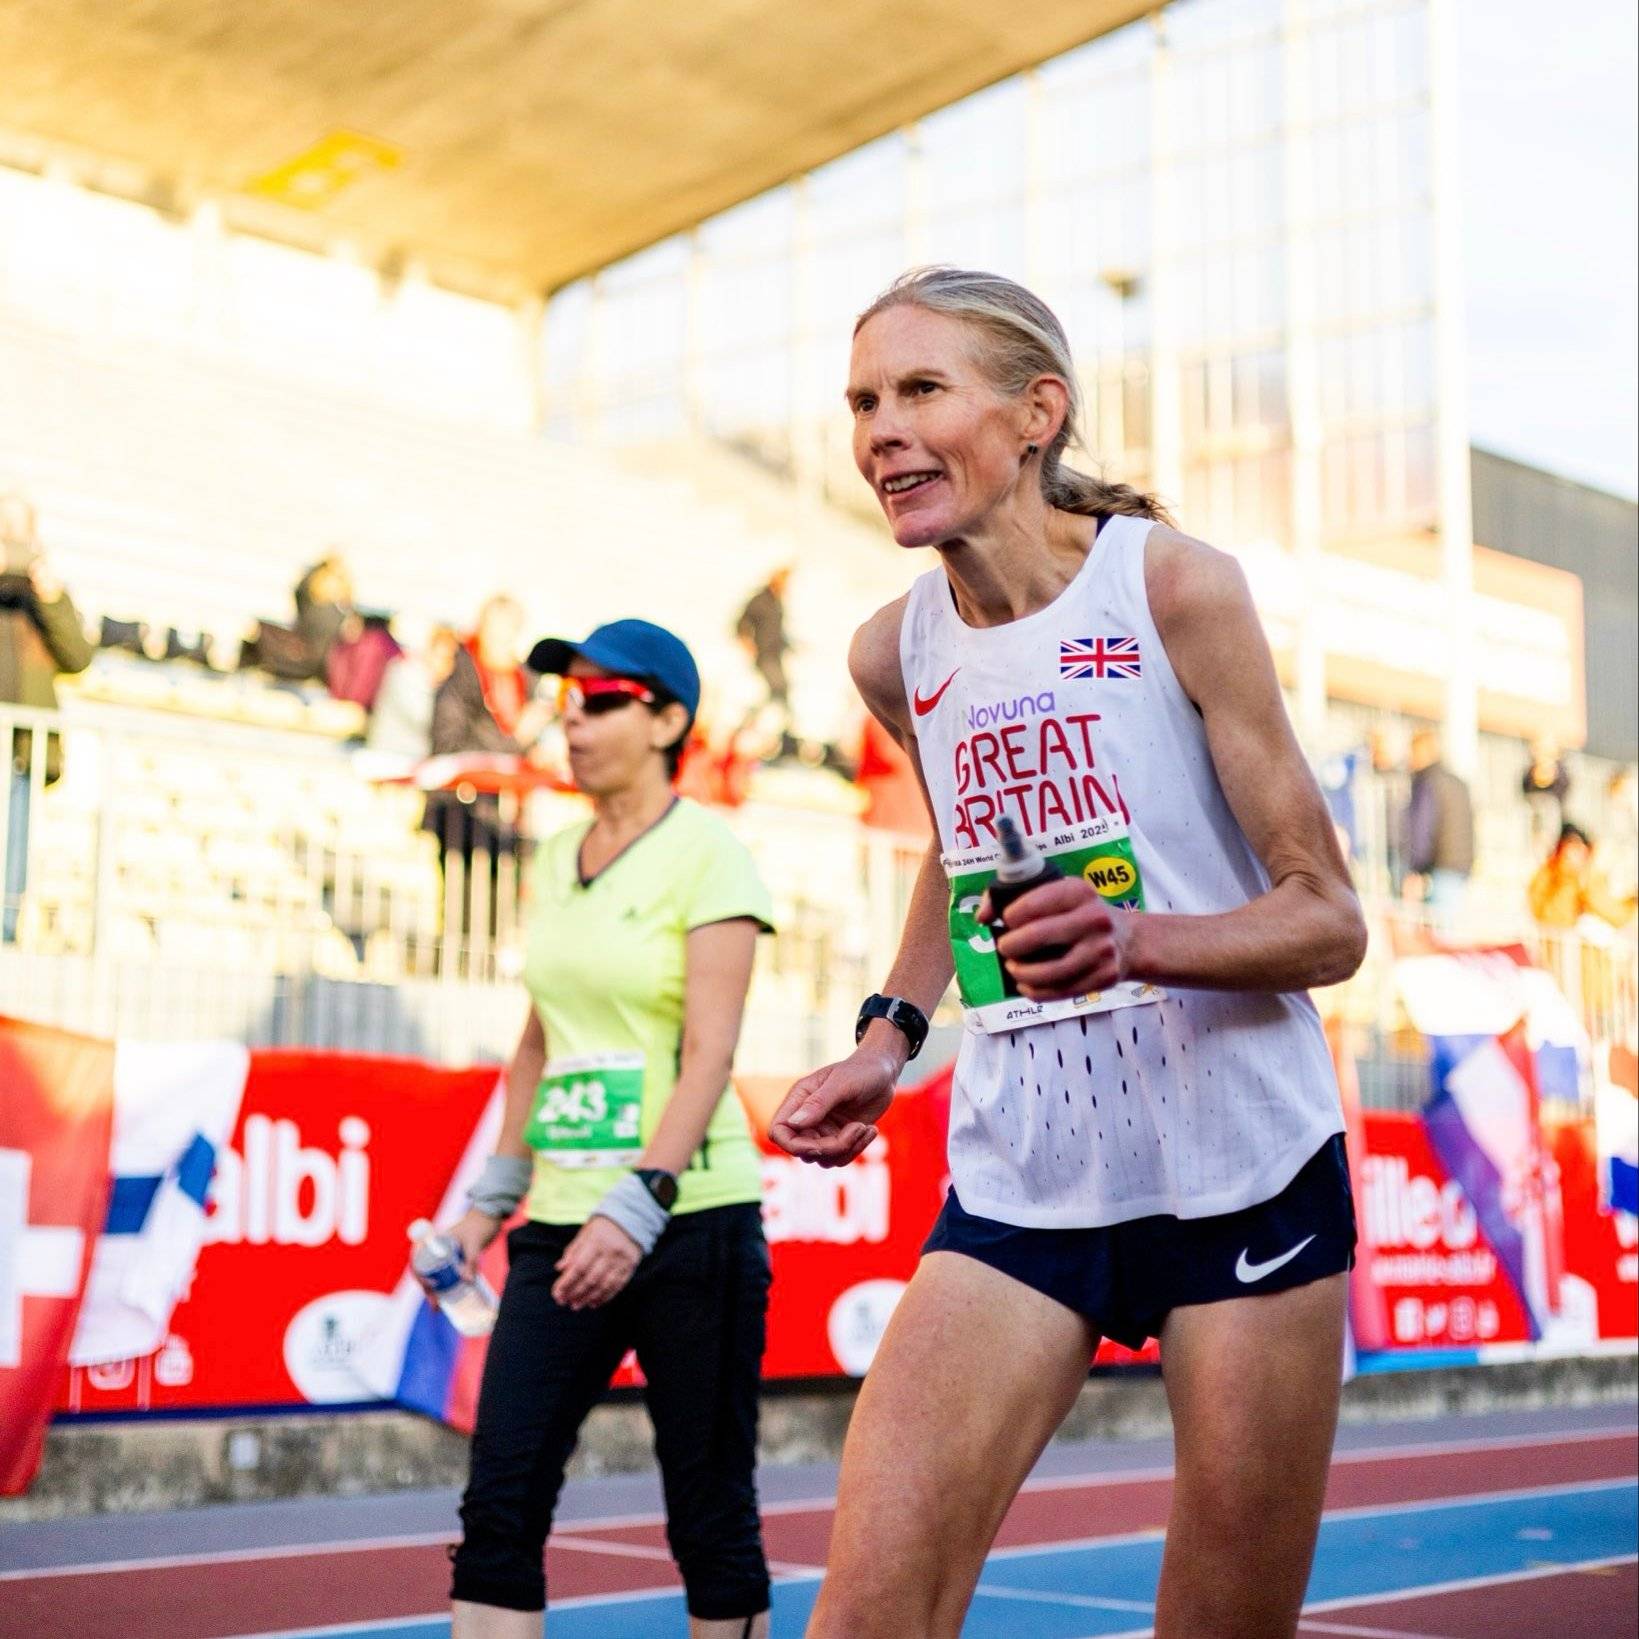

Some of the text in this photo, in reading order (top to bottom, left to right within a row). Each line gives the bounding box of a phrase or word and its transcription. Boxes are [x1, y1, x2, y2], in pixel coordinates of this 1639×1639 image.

[955, 713, 1102, 796] GREAT
[1053, 830, 1075, 845] Albi
[1088, 865, 1130, 888] W45
[538, 1080, 609, 1122] 243
[203, 1114, 372, 1247] albi
